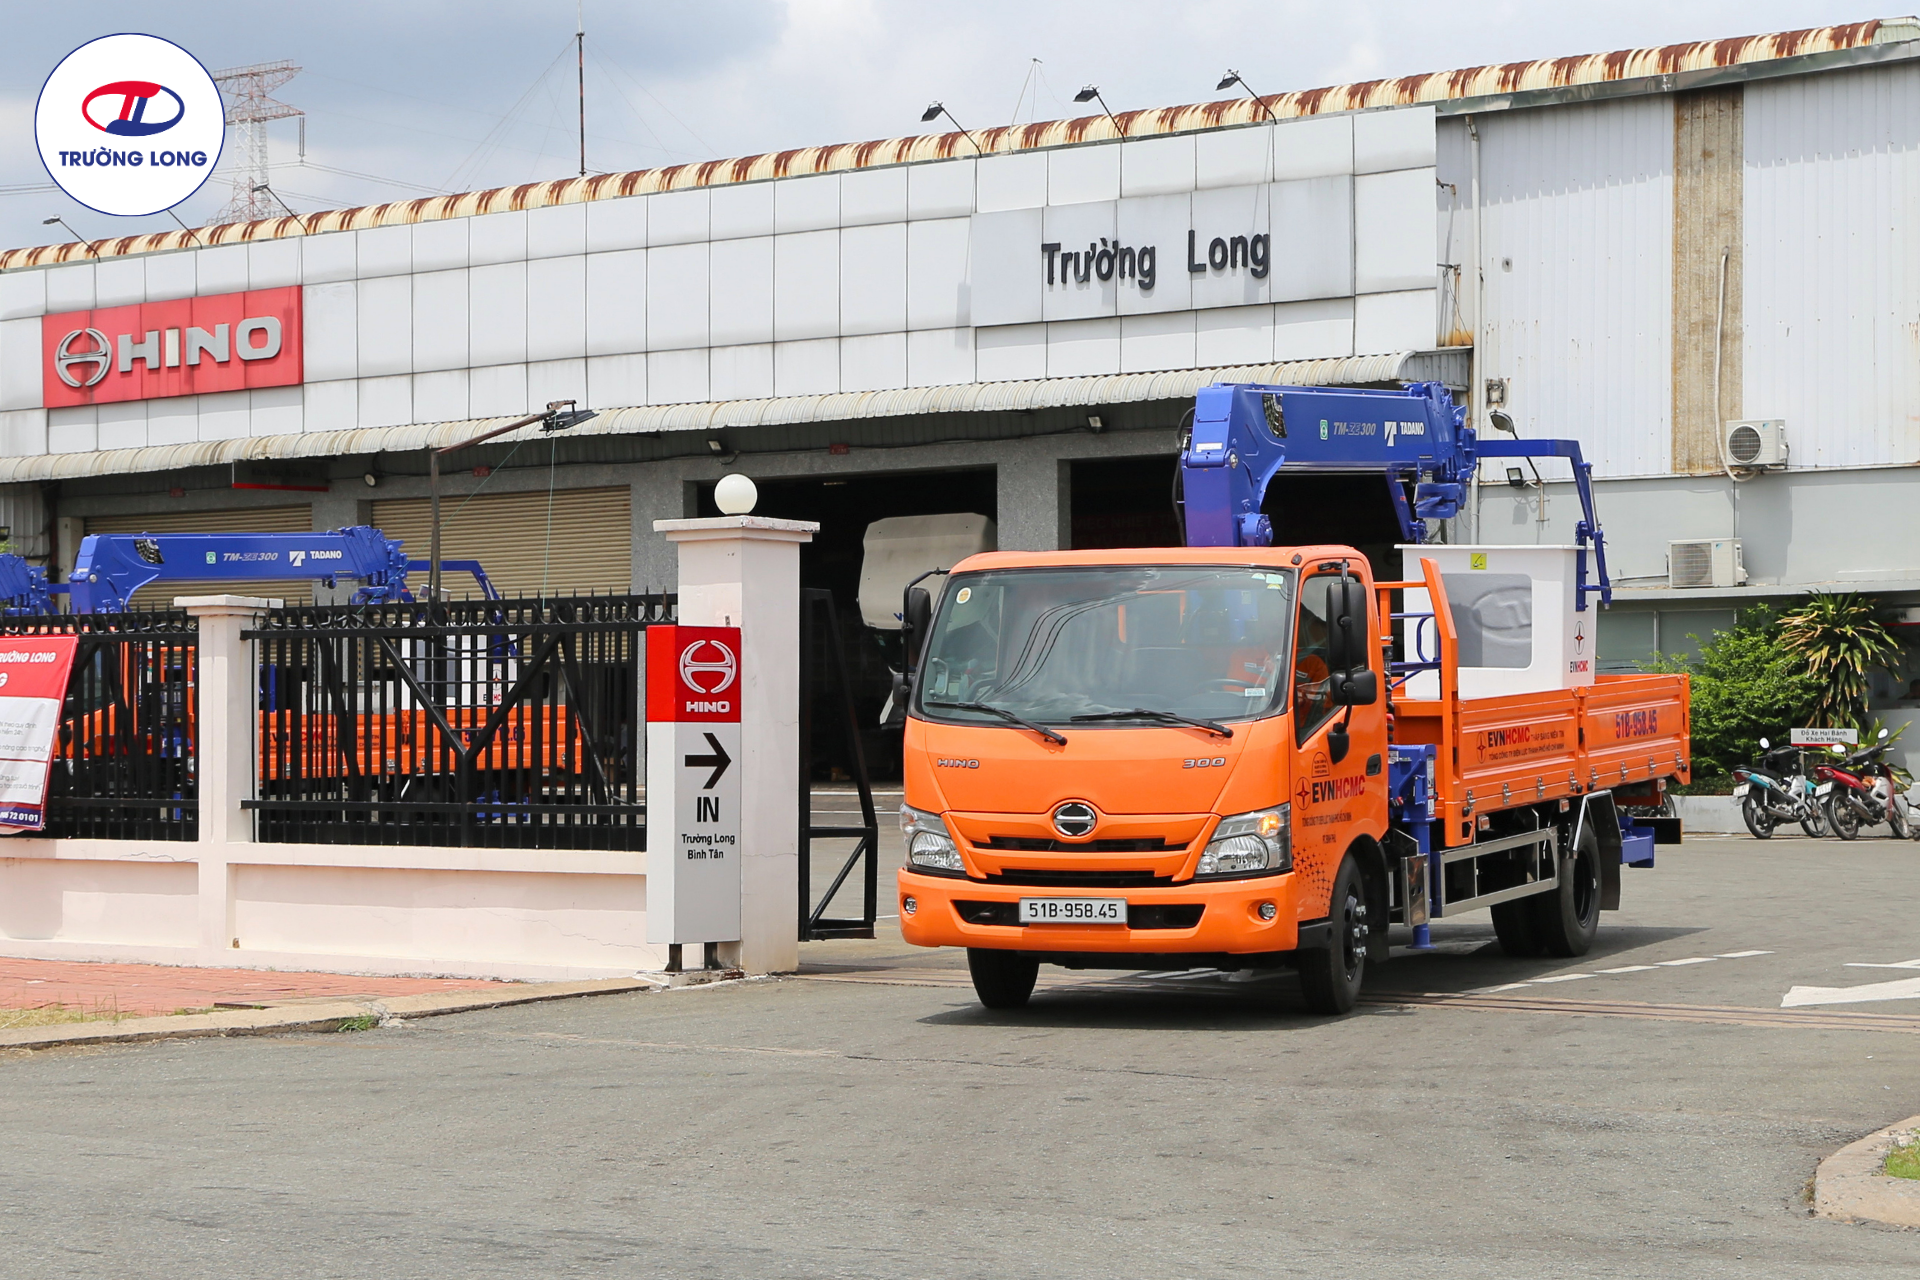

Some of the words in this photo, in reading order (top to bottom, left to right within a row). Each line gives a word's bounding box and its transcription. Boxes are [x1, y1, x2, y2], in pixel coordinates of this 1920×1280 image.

[1042, 237, 1156, 290] Trường
[1188, 229, 1270, 279] Long
[117, 315, 282, 374] HINO
[1399, 421, 1424, 435] TADANO
[309, 550, 342, 559] TADANO
[0, 650, 30, 663] RƯỜNG
[30, 652, 57, 663] LONG
[686, 701, 730, 713] HINO
[1615, 709, 1657, 739] 51B-958.45
[1488, 727, 1530, 748] EVNHCMC
[937, 758, 980, 769] HINO
[1182, 757, 1226, 769] 300
[1312, 775, 1365, 803] EVNHCMC
[696, 796, 719, 823] IN
[682, 833, 712, 846] Trường
[714, 833, 735, 845] Long
[688, 849, 707, 860] Bình
[708, 848, 724, 859] Tân
[1029, 903, 1118, 919] 51B-958.45
